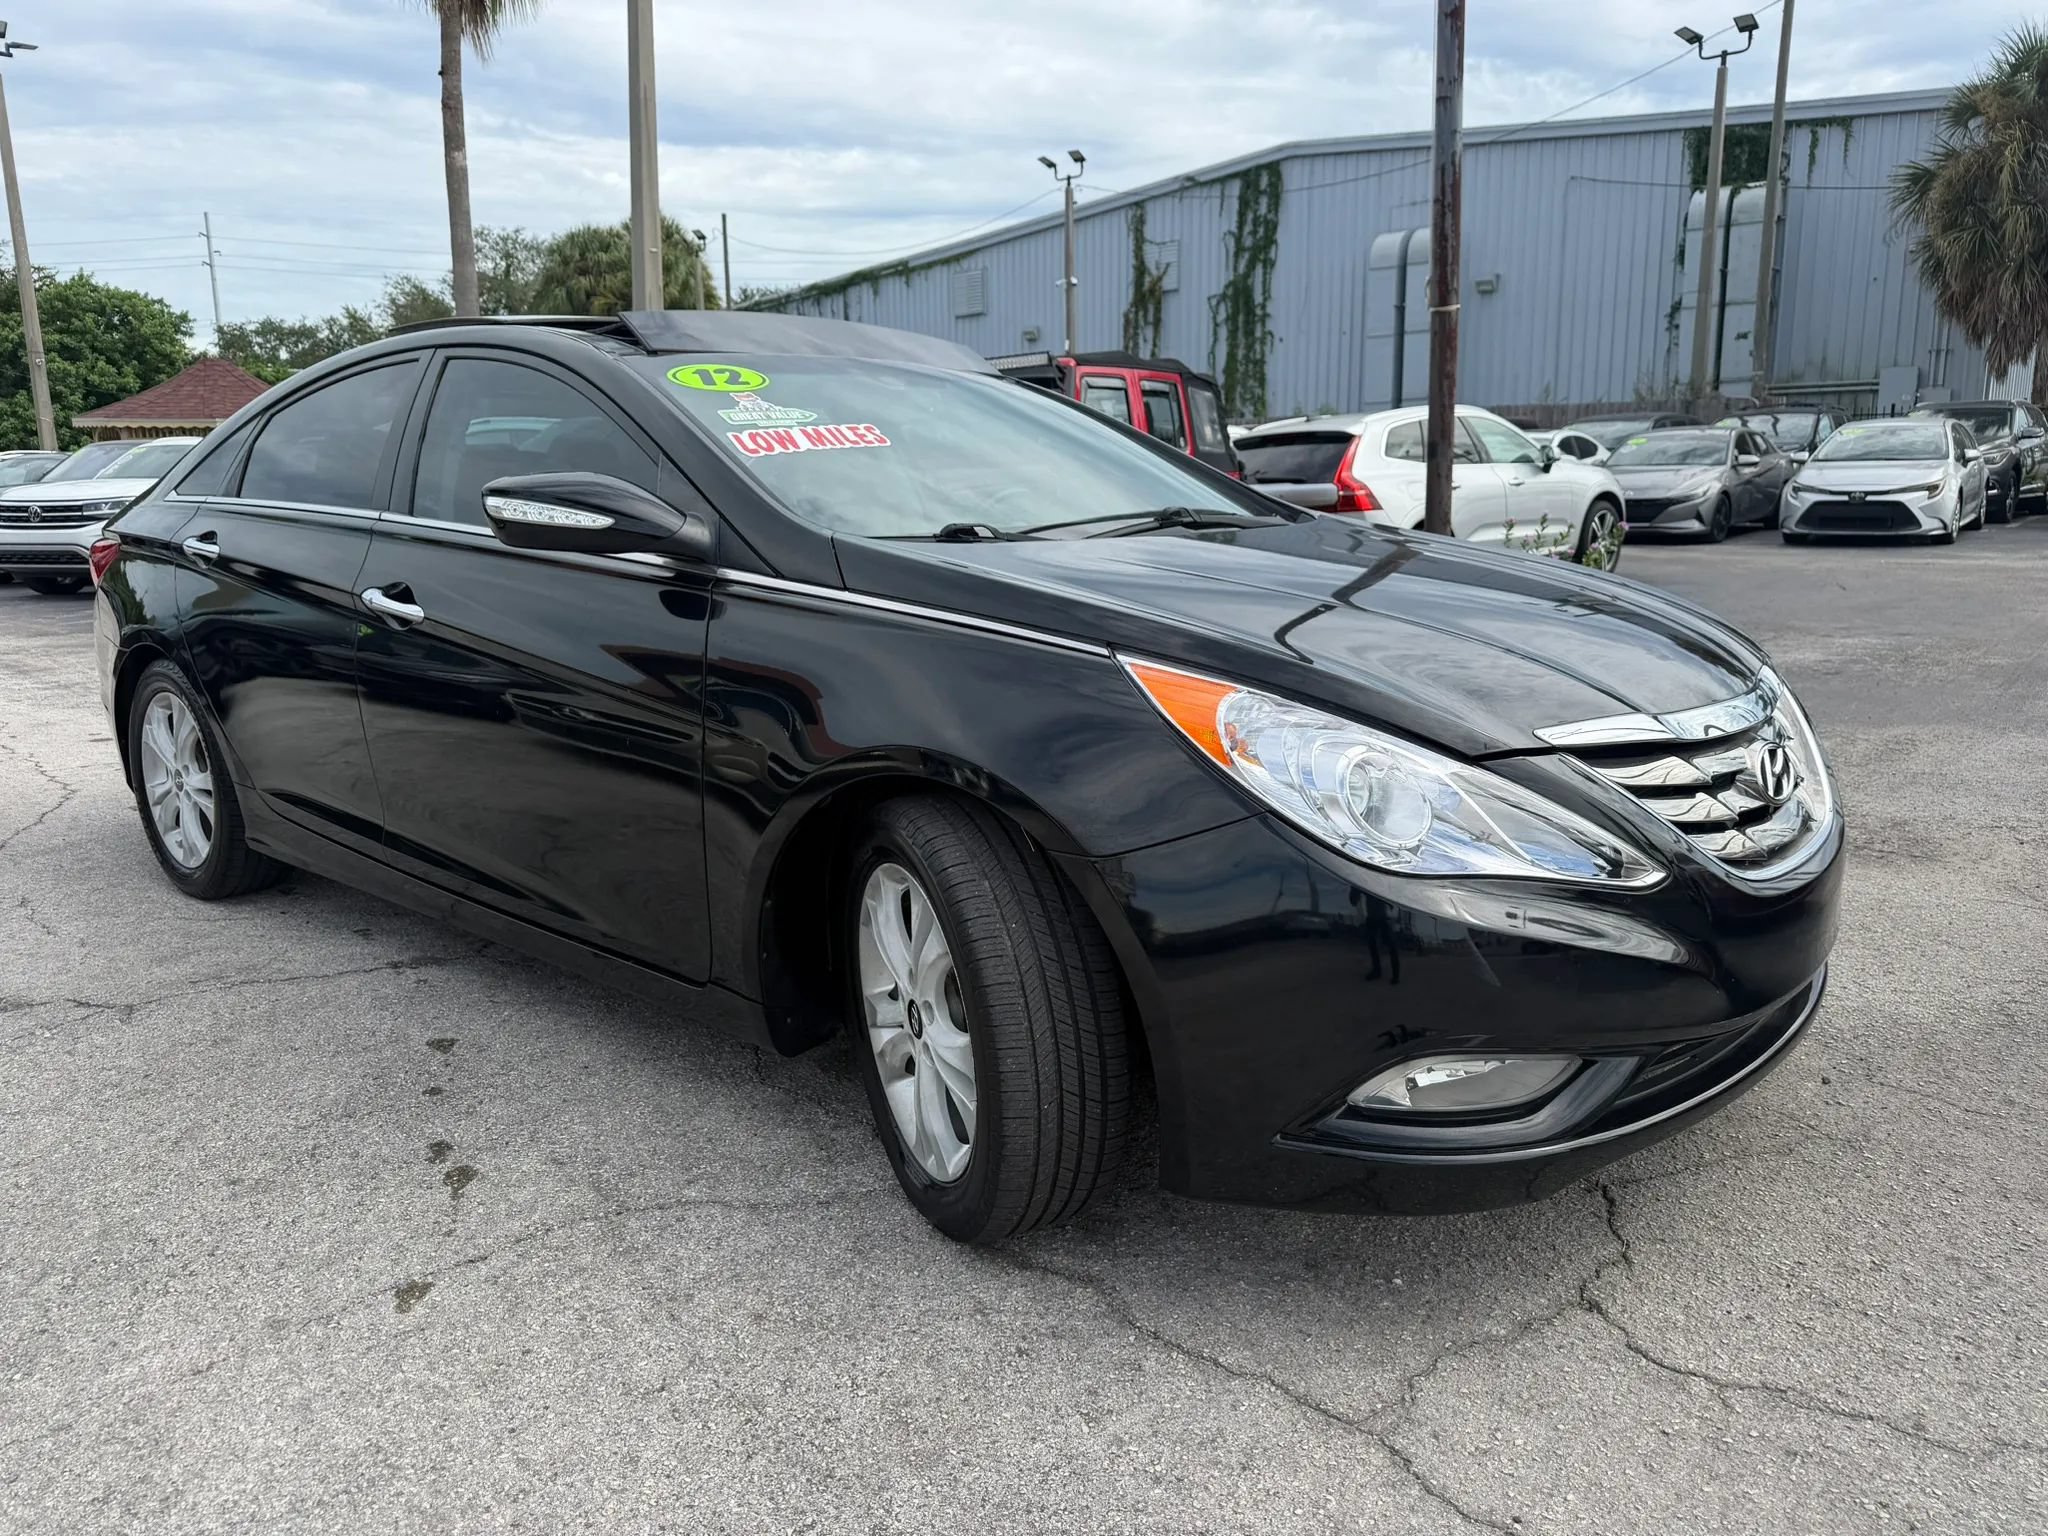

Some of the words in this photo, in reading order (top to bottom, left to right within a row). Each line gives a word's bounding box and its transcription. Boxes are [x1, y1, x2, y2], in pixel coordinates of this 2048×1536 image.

[692, 368, 751, 386] 12
[767, 411, 805, 419] VALUE
[731, 429, 800, 455] LOW
[799, 425, 887, 447] MILES
